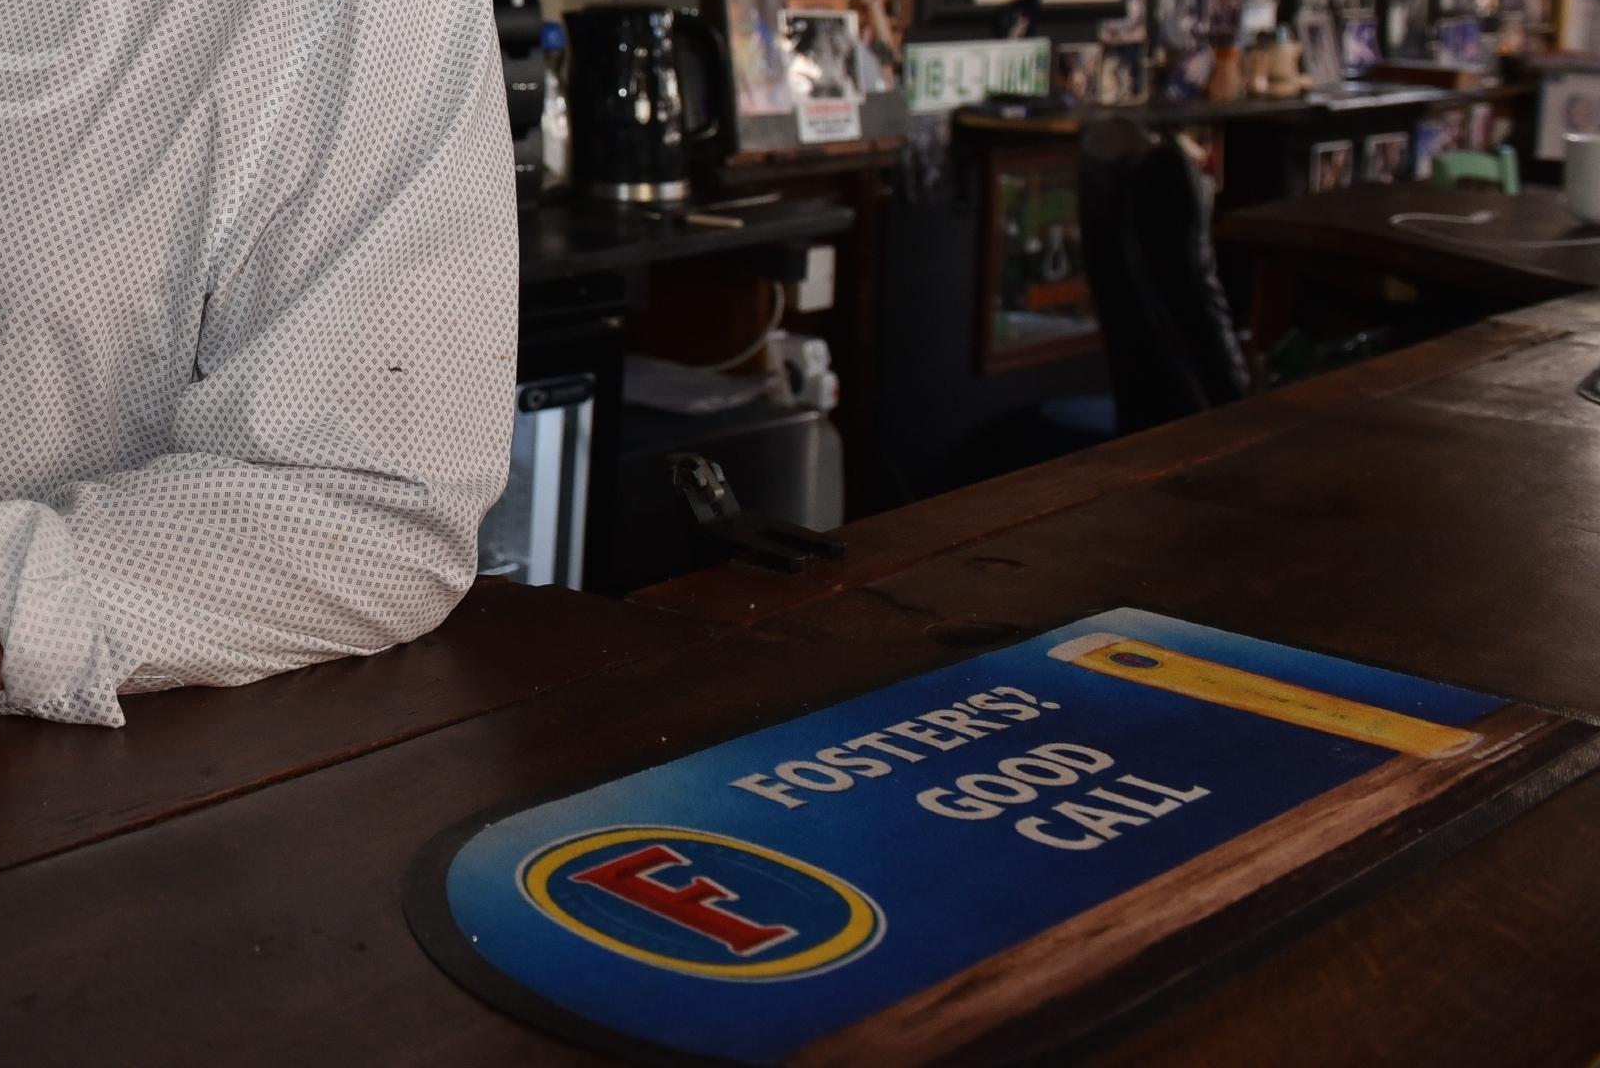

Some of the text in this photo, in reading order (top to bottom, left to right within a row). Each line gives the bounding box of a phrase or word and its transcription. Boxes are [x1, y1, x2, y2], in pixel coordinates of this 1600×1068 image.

[730, 684, 1064, 810] FOSTER'S?
[915, 740, 1117, 823] GOOD
[1012, 773, 1212, 853] CALL
[570, 844, 800, 956] F
